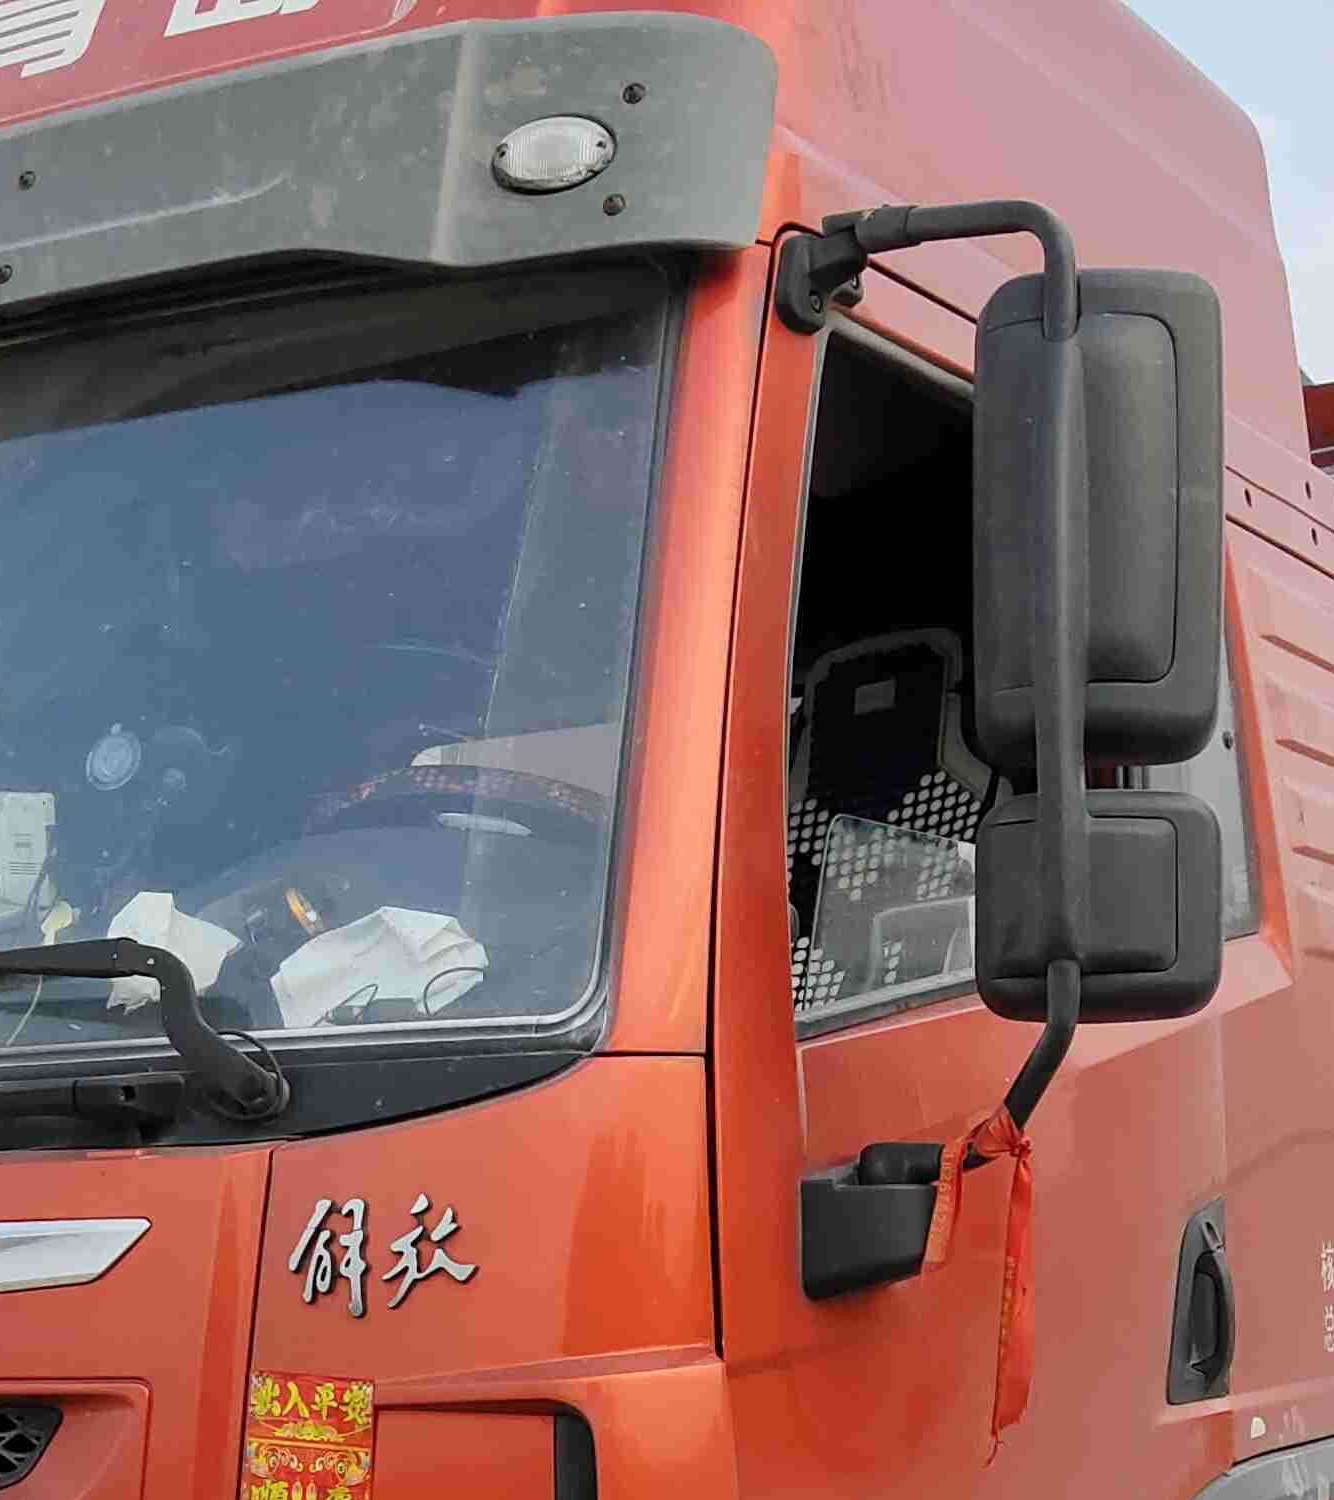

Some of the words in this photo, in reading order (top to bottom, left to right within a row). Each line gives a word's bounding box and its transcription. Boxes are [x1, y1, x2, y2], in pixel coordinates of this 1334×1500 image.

[289, 1193, 476, 1317] 解放
[250, 1375, 373, 1426] 出入平安
